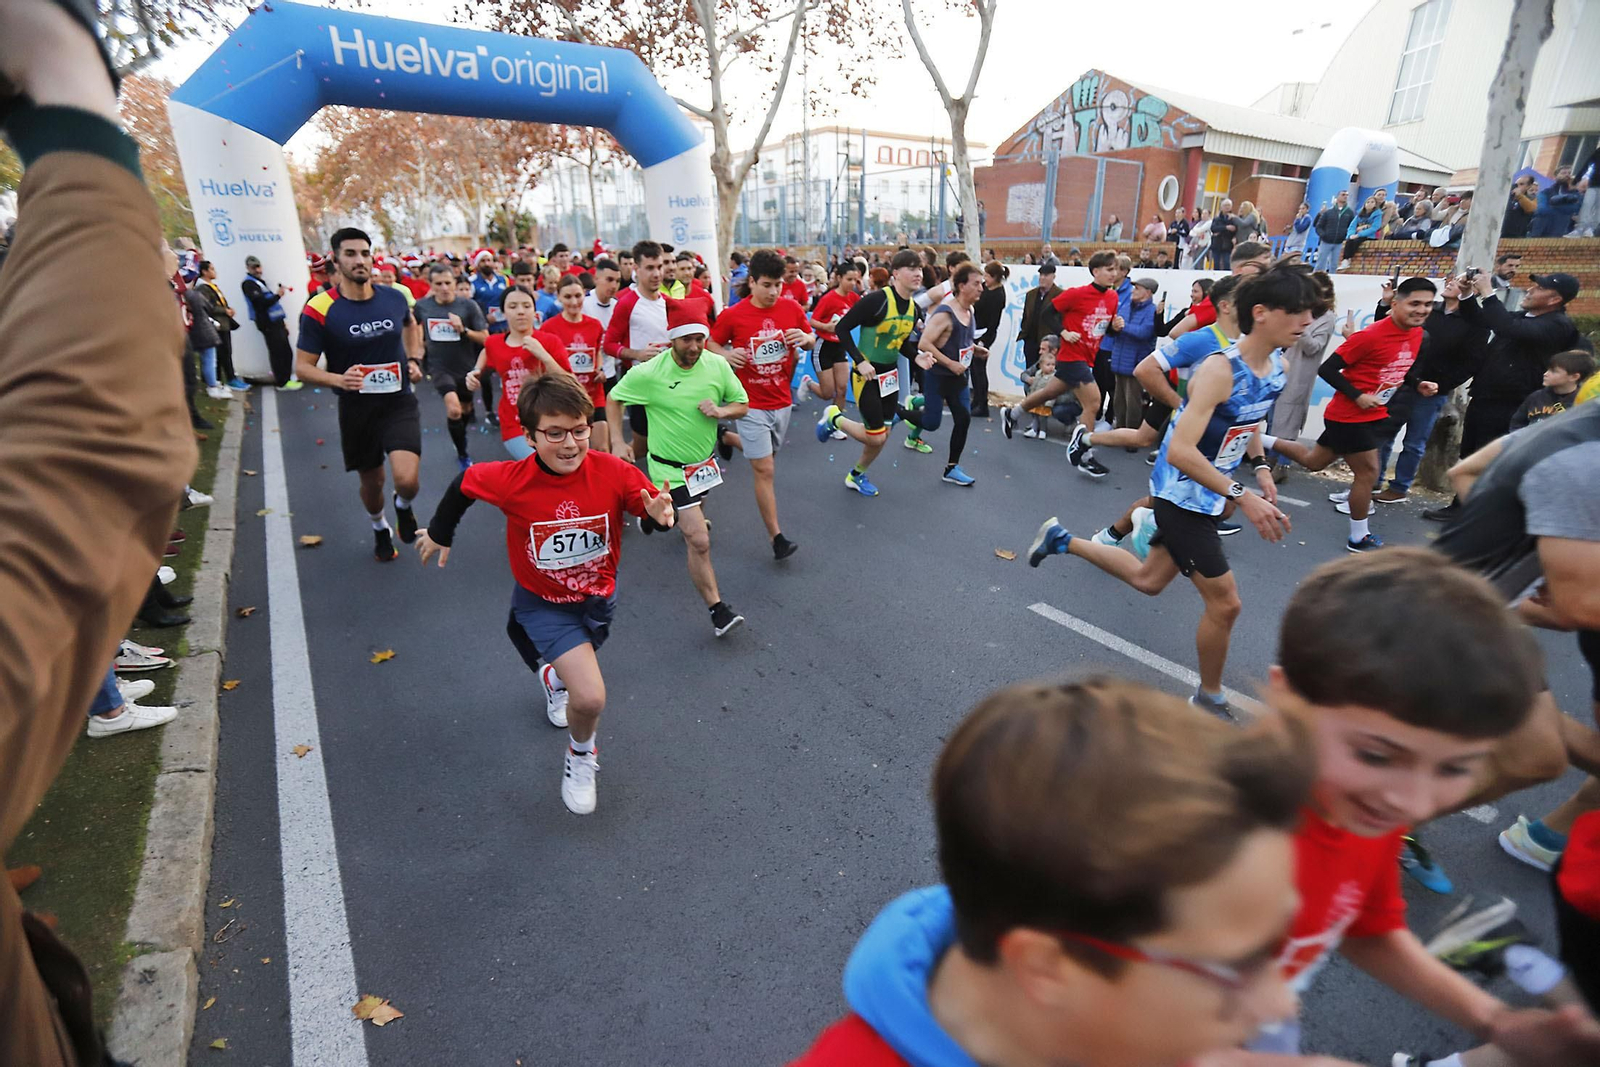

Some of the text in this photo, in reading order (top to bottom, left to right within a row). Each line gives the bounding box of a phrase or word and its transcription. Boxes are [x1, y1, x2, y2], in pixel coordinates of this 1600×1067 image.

[329, 25, 608, 97] Huelva original
[199, 179, 274, 198] Huelva
[238, 233, 283, 242] HUELVA
[761, 341, 780, 355] 389
[575, 355, 587, 365] 20
[369, 371, 392, 384] 454
[553, 531, 589, 553] 571
